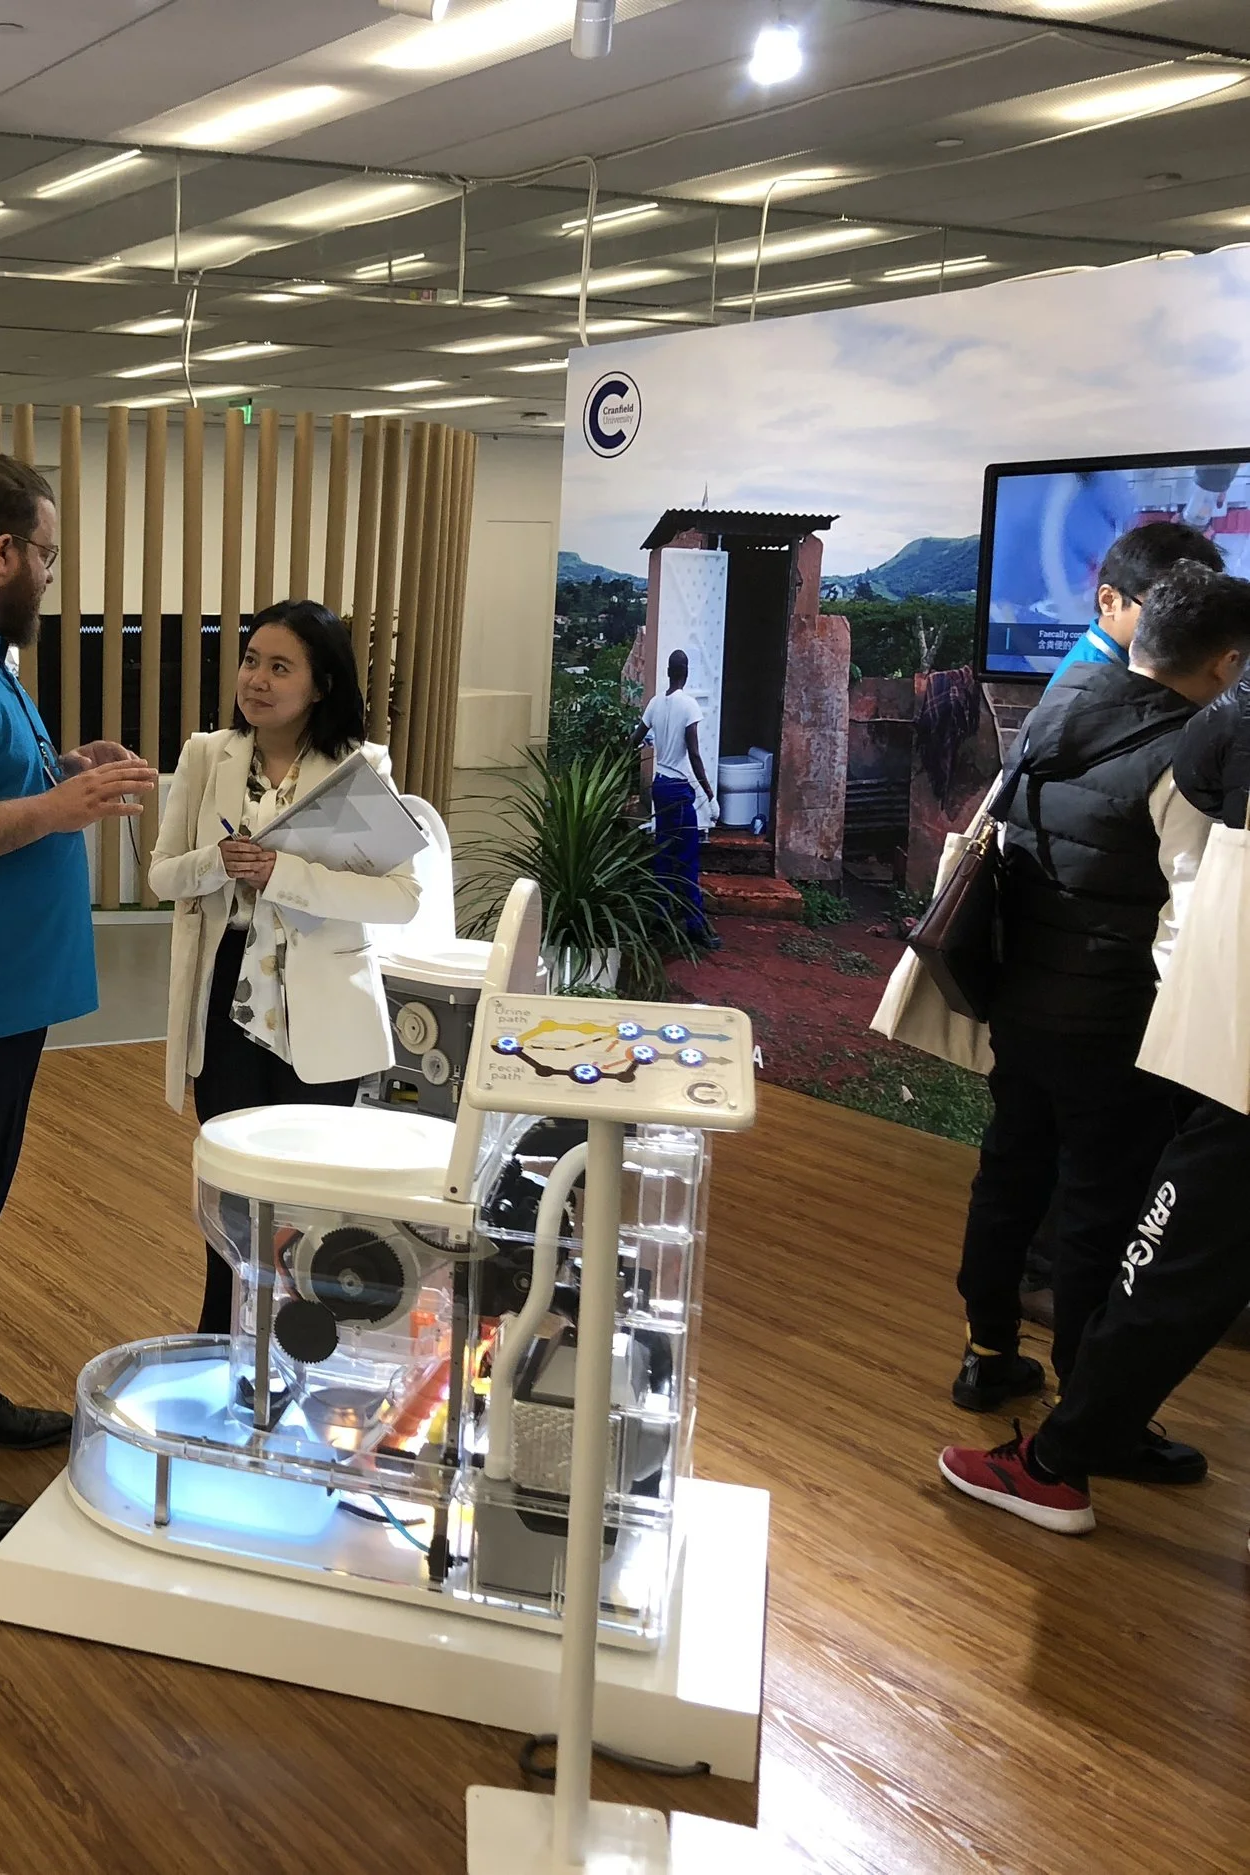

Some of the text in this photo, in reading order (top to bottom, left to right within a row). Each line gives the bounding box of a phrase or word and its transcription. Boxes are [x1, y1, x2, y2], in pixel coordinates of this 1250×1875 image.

[602, 403, 634, 415] Cranfield
[603, 414, 634, 425] University
[1038, 629, 1069, 640] Faecally
[498, 1015, 528, 1024] path
[489, 1063, 526, 1074] Fecal
[490, 1072, 522, 1083] path
